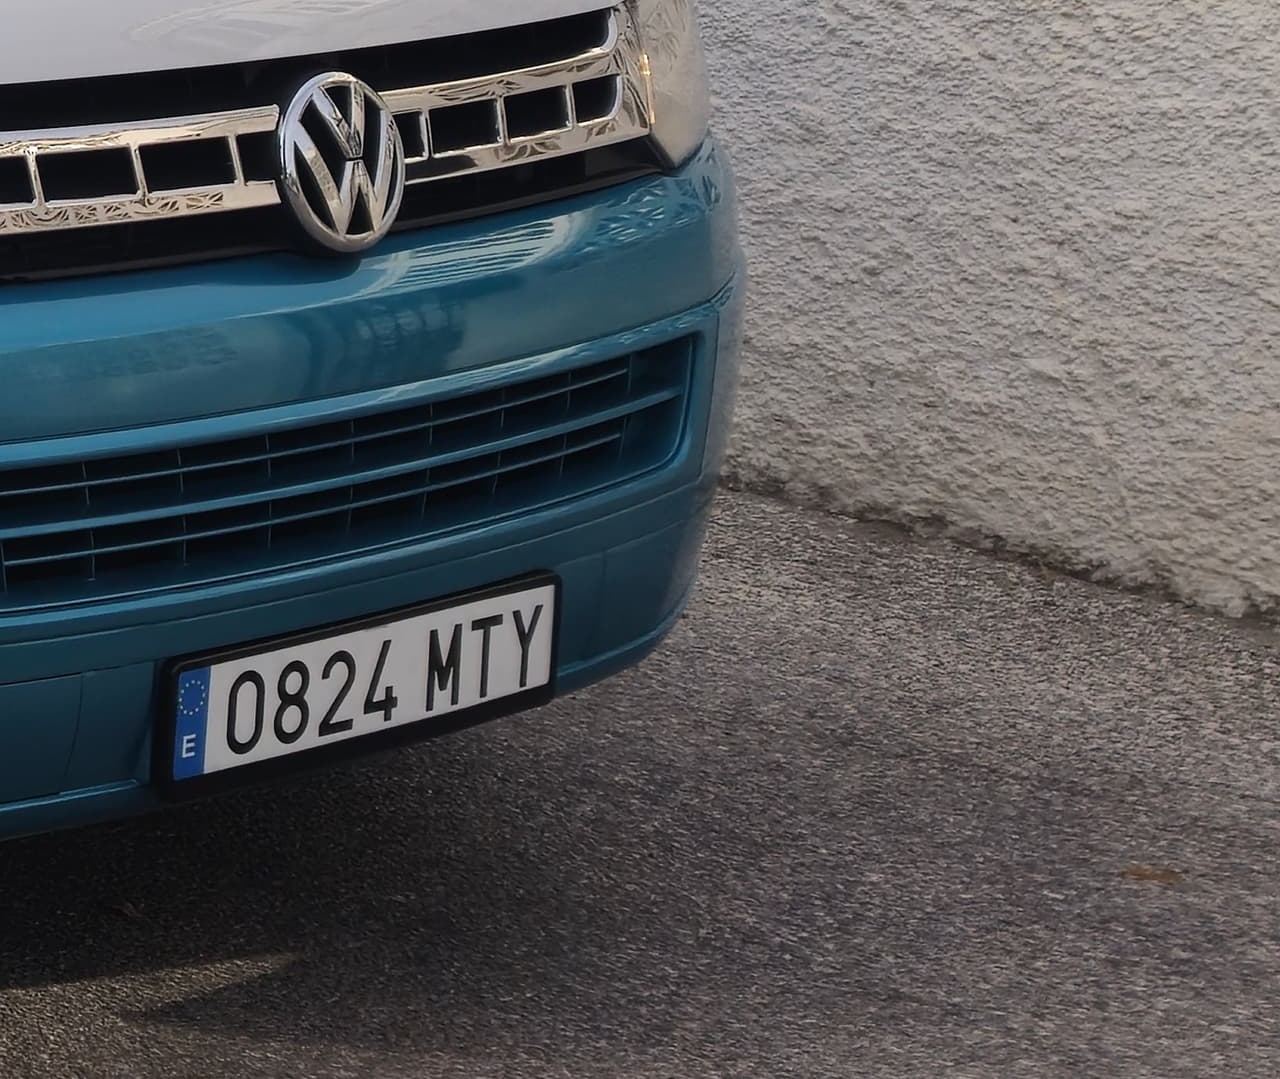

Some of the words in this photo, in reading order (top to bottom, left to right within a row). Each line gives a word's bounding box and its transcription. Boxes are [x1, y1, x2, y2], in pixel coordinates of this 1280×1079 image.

[284, 75, 403, 248] VW
[181, 734, 196, 758] E
[226, 640, 398, 755] 0824
[426, 604, 544, 712] MTY
